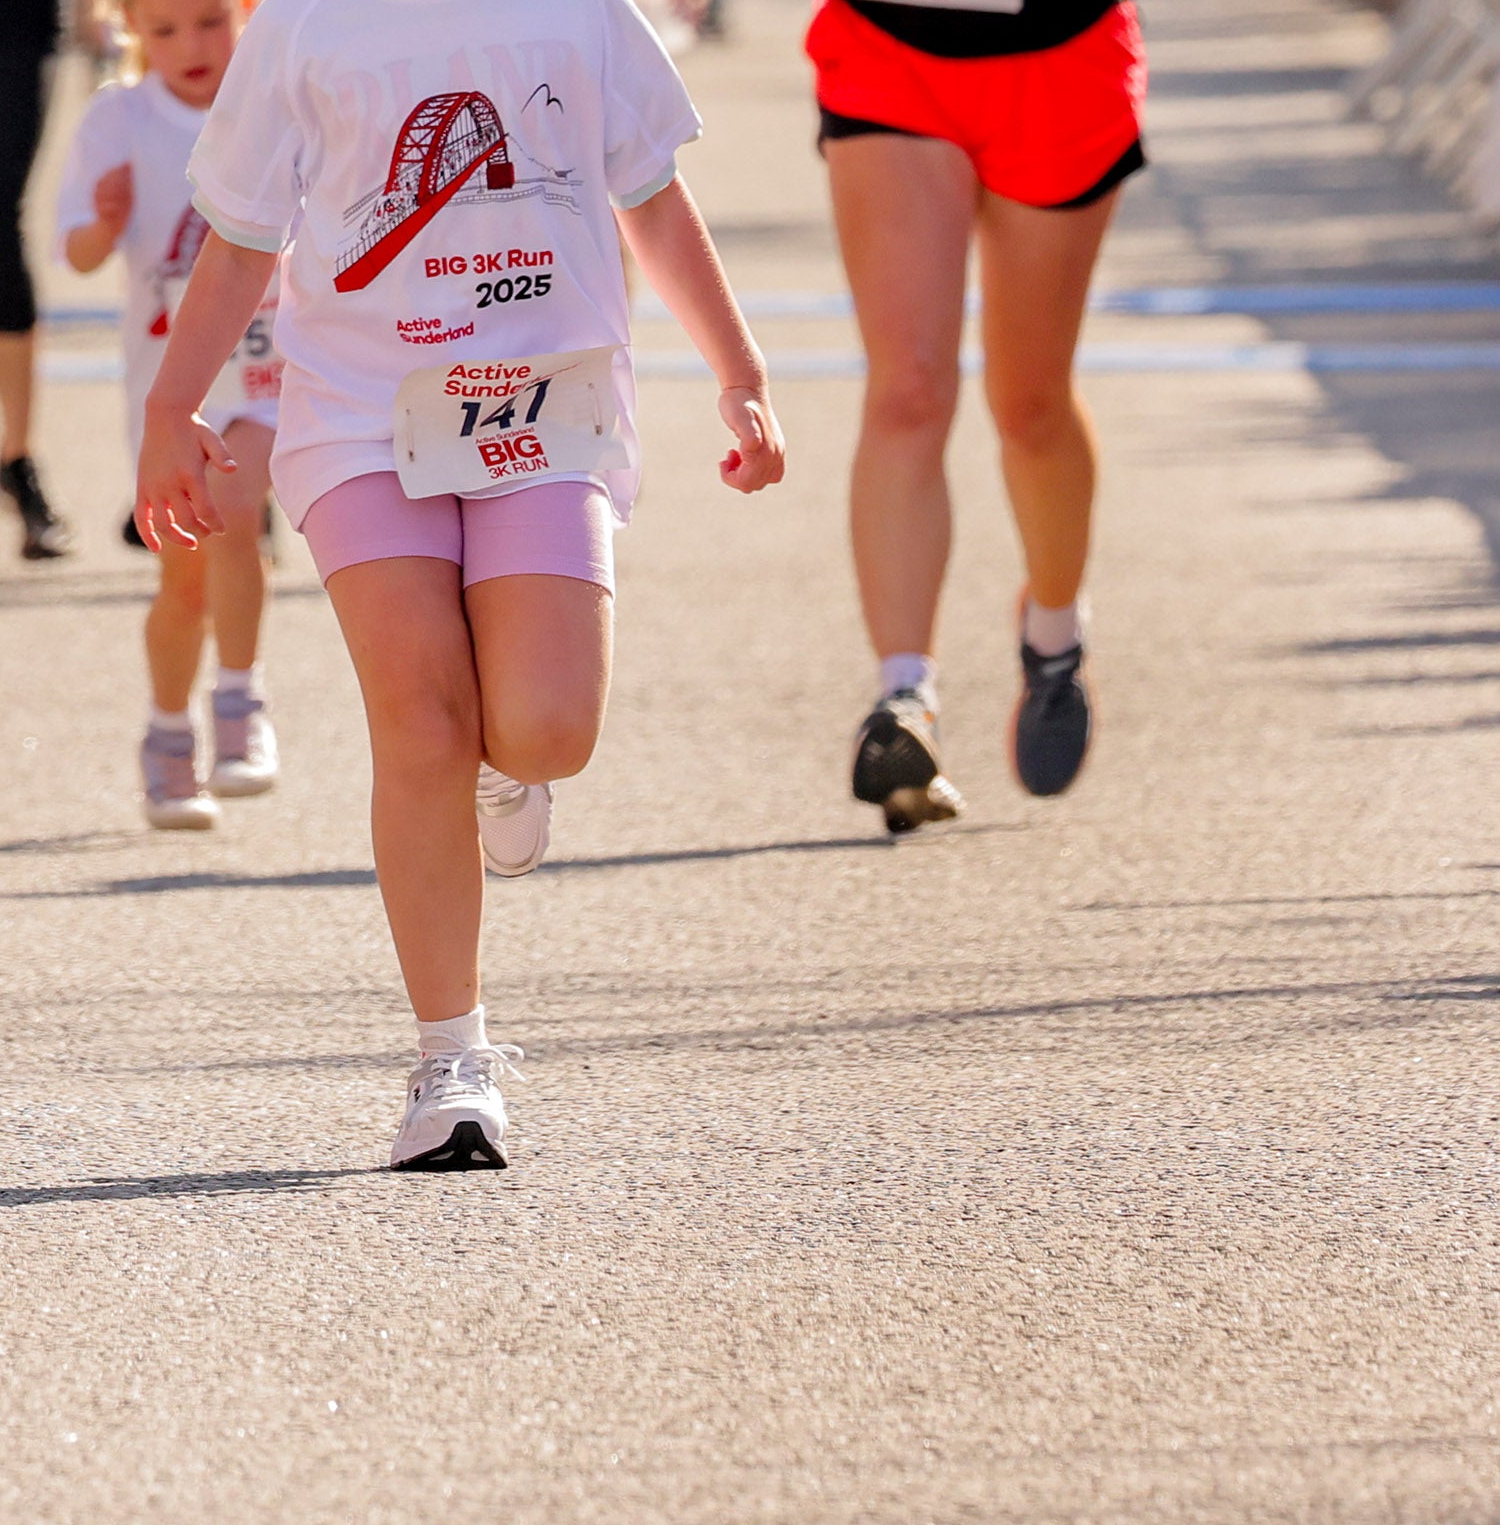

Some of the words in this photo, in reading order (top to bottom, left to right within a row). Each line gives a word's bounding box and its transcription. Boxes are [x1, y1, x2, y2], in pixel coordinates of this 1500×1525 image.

[425, 256, 467, 278] BIG
[473, 252, 503, 274] 3K
[507, 249, 553, 268] Run
[475, 274, 552, 308] 2025
[397, 317, 442, 332] Active
[399, 321, 474, 345] Sunderland
[447, 363, 531, 380] Active
[459, 378, 553, 437] 147
[478, 434, 544, 467] BIG
[488, 465, 512, 480] 3K
[513, 456, 549, 475] RUN
